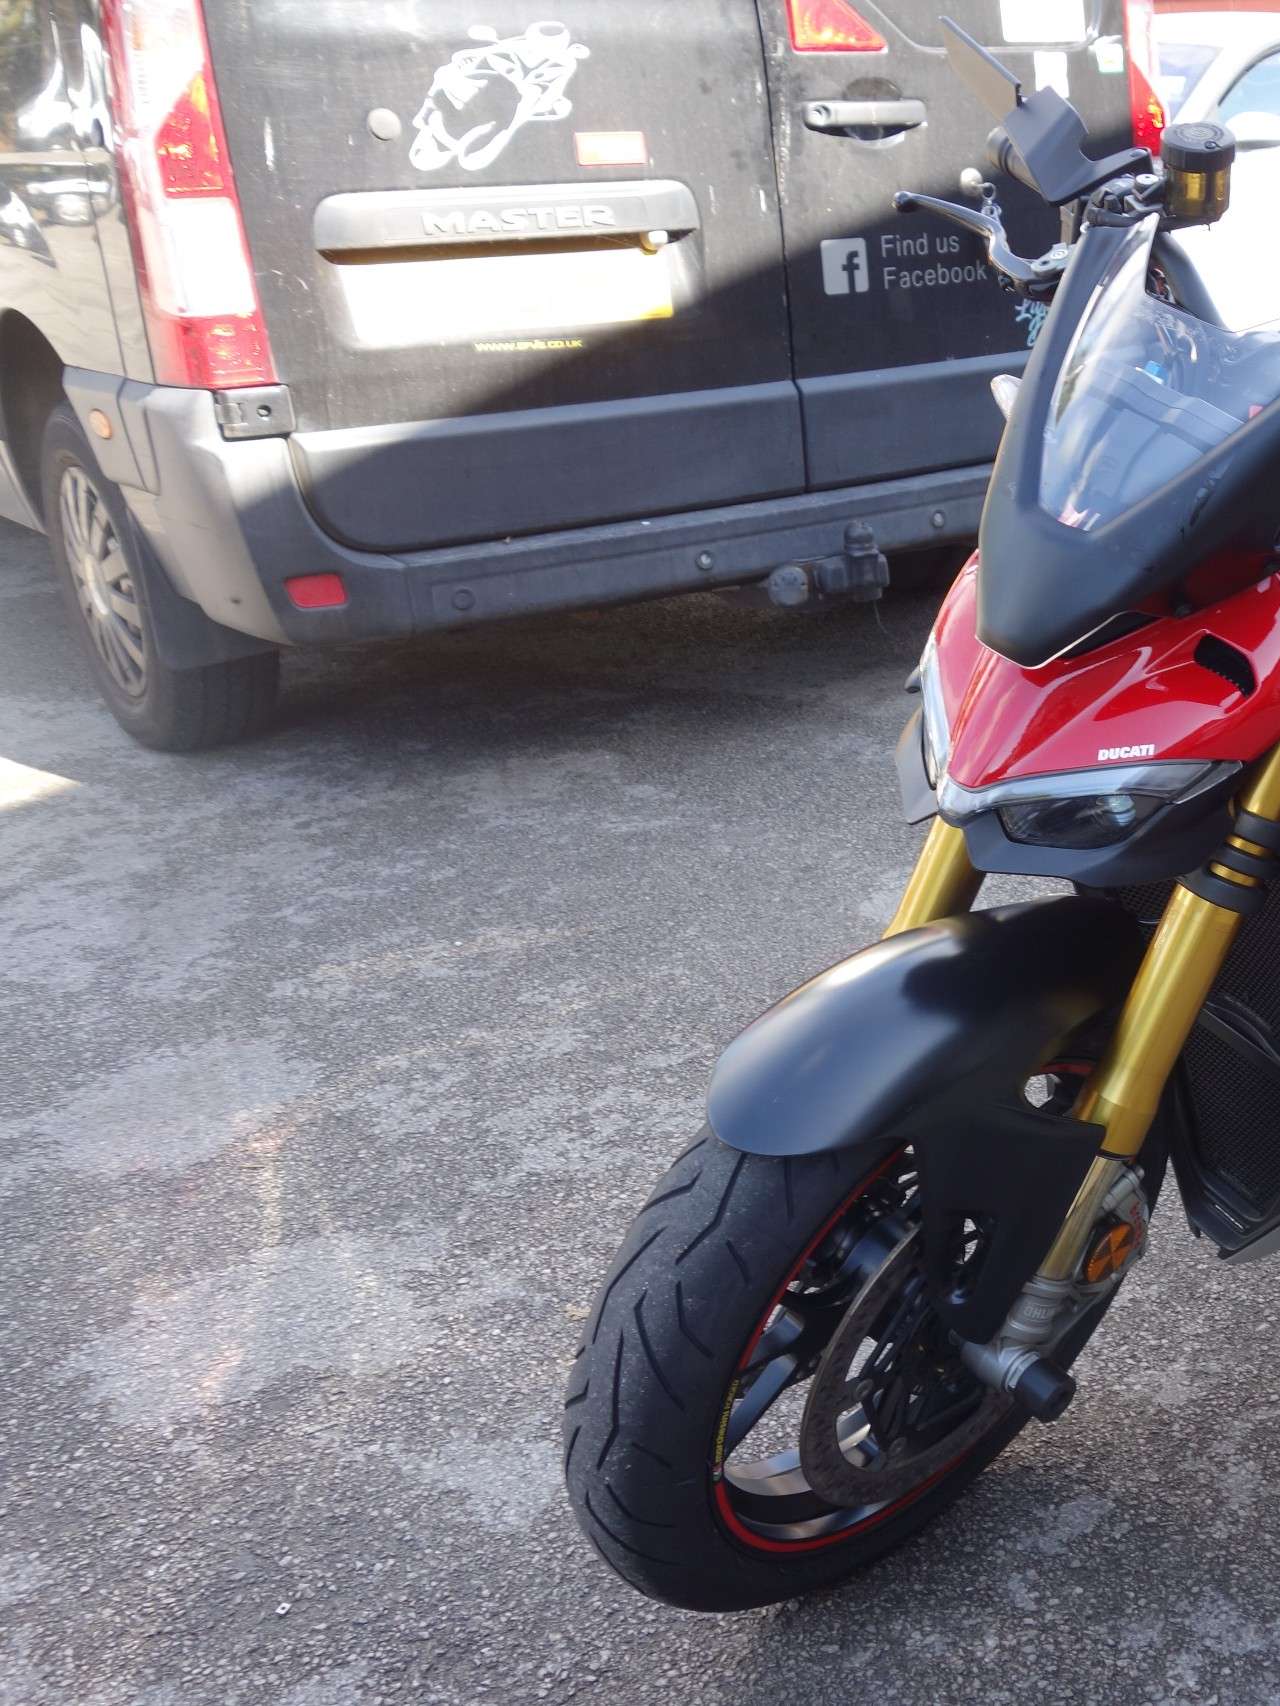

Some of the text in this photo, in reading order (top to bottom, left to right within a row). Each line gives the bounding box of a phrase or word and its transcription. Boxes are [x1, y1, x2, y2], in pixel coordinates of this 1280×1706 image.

[421, 204, 617, 236] MASTER
[880, 233, 961, 258] Find us
[882, 259, 988, 290] Facebook
[1097, 744, 1156, 761] DUCATI
